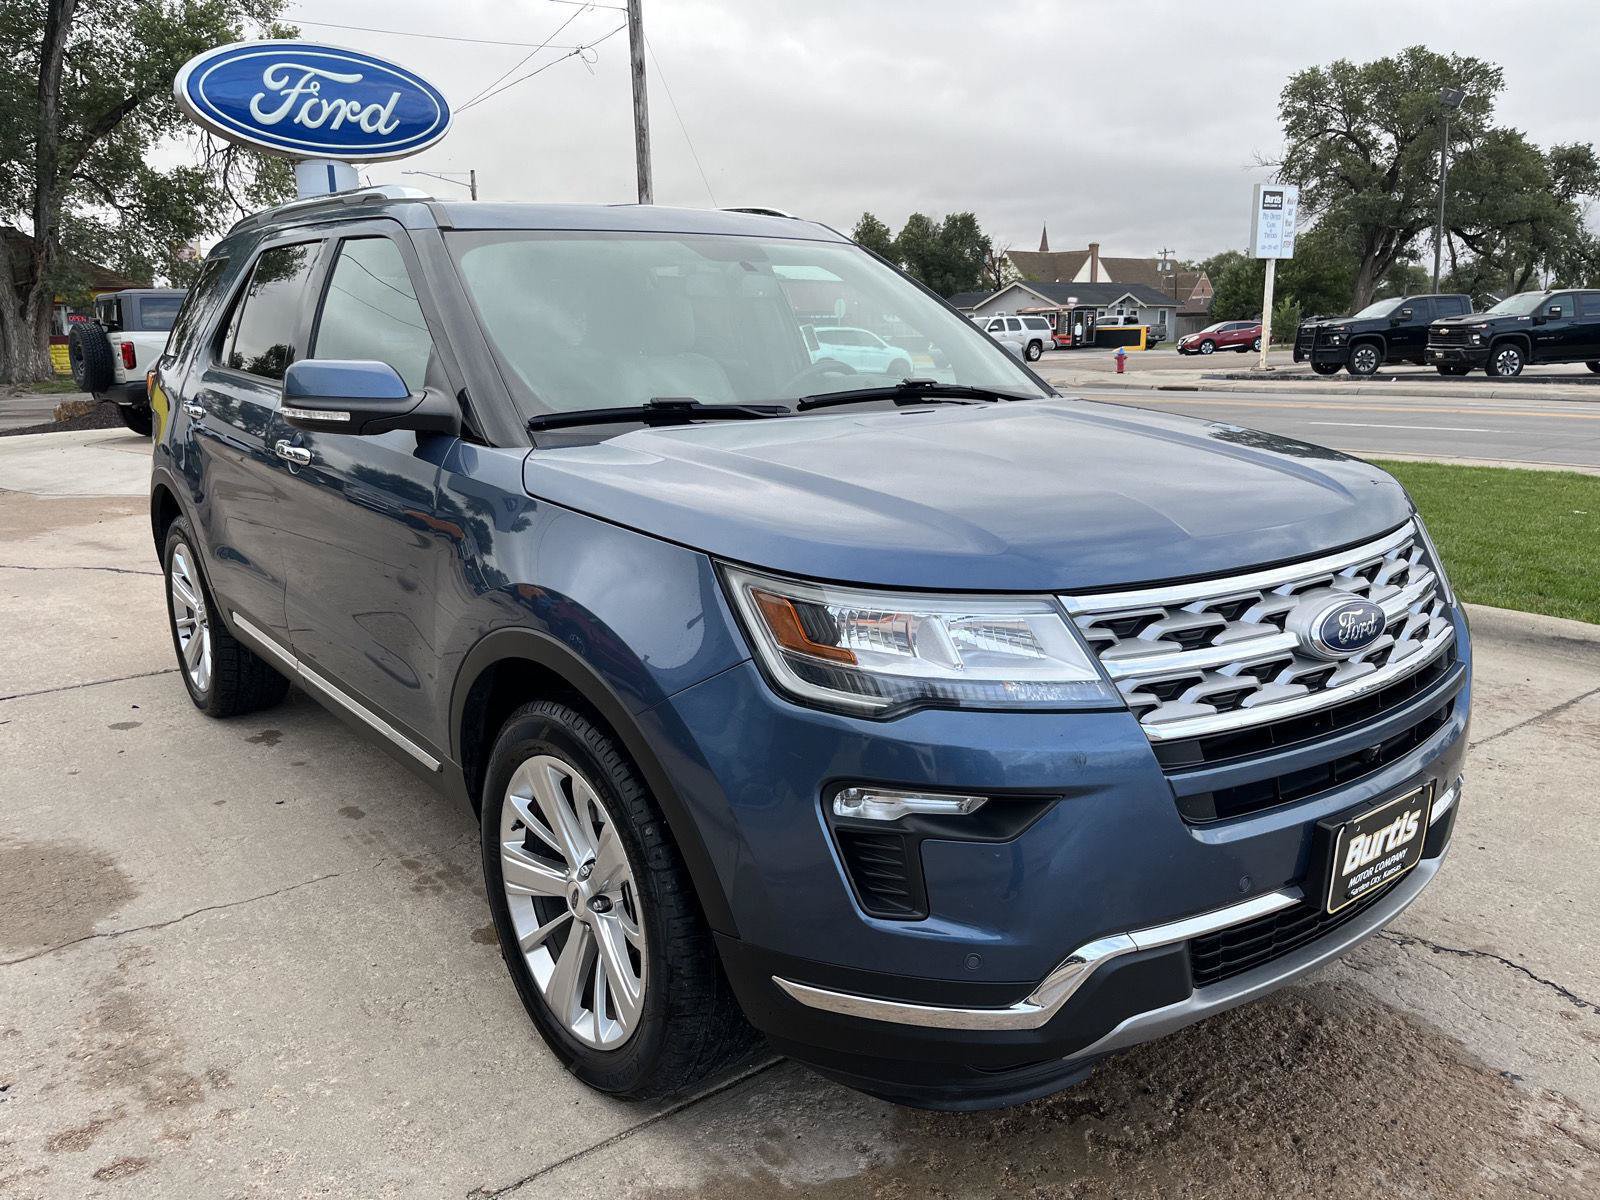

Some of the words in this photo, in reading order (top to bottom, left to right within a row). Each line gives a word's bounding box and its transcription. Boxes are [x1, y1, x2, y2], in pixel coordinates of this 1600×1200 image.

[250, 63, 402, 136] Ford
[1338, 608, 1377, 645] Ford
[1341, 809, 1422, 877] Burtis
[1347, 866, 1375, 889] MOTOR
[1374, 847, 1408, 873] COMPANY
[1382, 863, 1402, 879] Kansas
